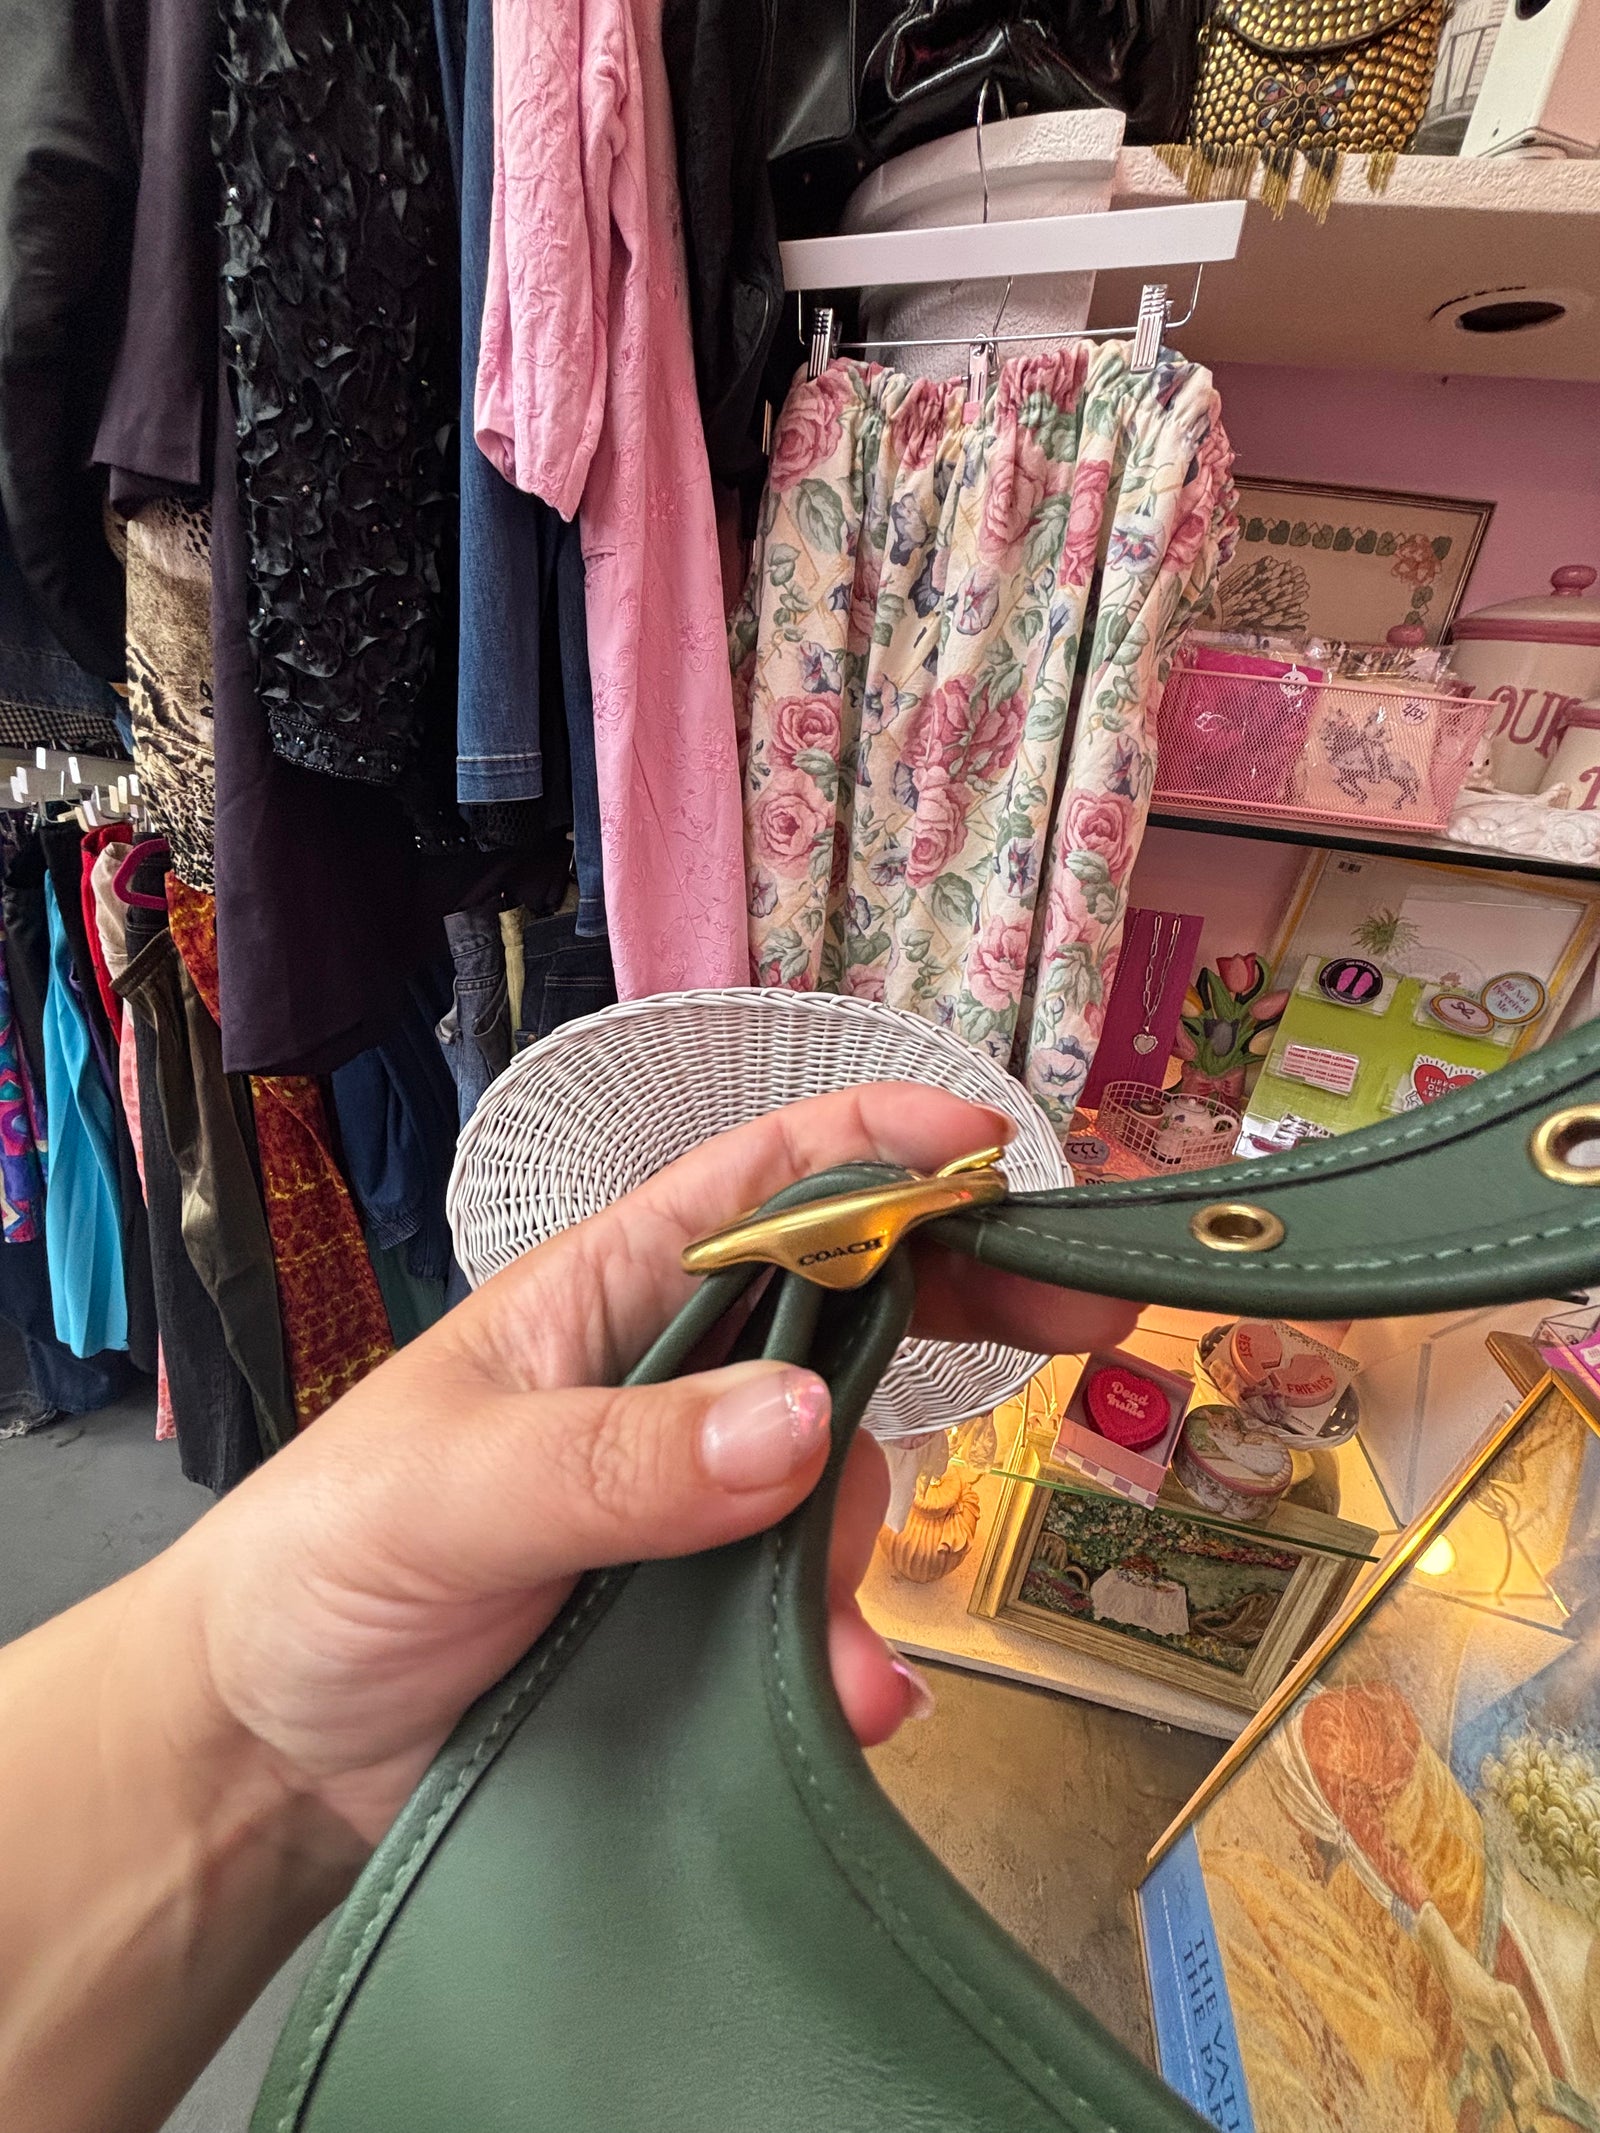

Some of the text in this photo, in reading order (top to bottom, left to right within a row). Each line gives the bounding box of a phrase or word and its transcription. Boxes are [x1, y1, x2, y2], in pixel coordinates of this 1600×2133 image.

[1492, 984, 1526, 1014] Perceive
[1502, 980, 1530, 1005] Do Not
[1496, 1000, 1508, 1013] Me
[1288, 1051, 1305, 1059] THANK
[1330, 1061, 1354, 1071] LEAVING
[1424, 1075, 1457, 1090] SUPPO
[799, 1236, 884, 1266] COACH
[1239, 1333, 1254, 1358] BEST
[1111, 1381, 1149, 1406] Dead
[1286, 1375, 1333, 1396] FRIENDS
[1106, 1393, 1146, 1419] Inside
[1183, 1940, 1206, 2027] THE
[1195, 1928, 1218, 2017] THE
